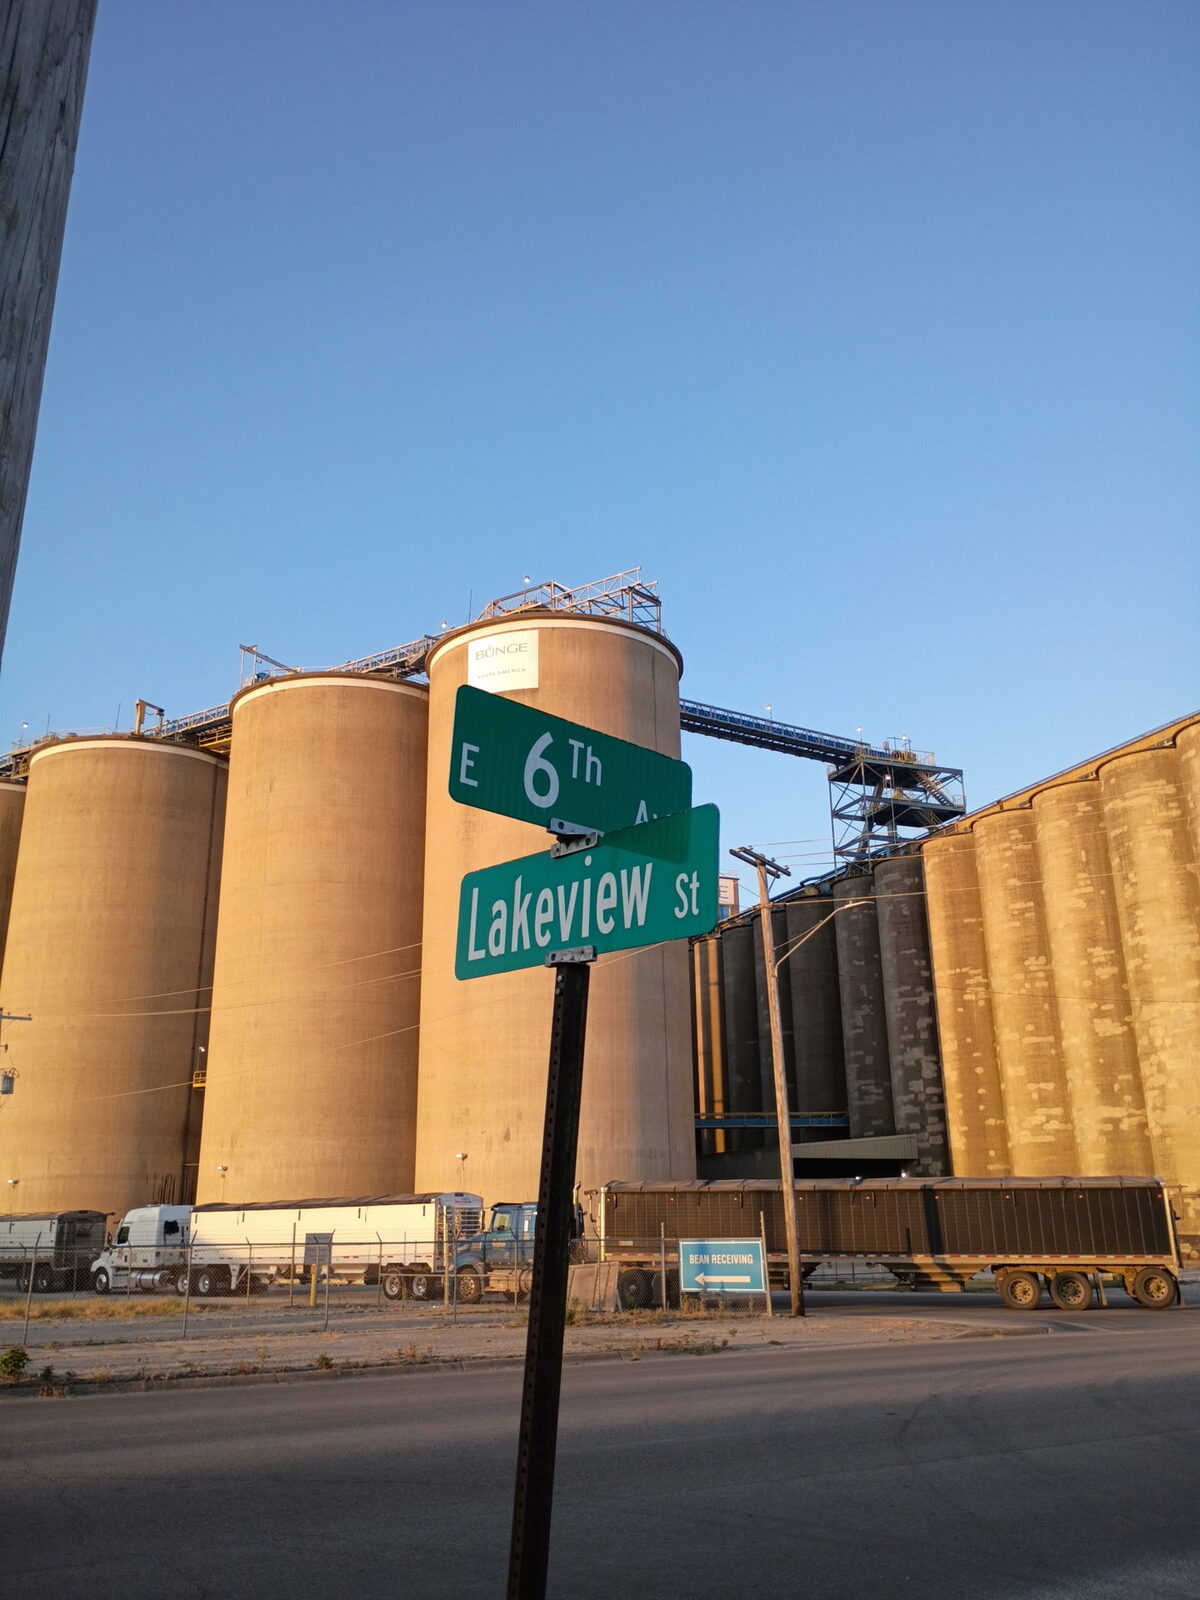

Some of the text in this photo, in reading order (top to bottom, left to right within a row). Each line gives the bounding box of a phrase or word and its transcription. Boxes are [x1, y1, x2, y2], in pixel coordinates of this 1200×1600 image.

[475, 642, 529, 661] BUNGE
[459, 742, 480, 787] E
[467, 855, 700, 961] Lakeview St
[689, 1254, 754, 1264] BEAN RECEIVING
